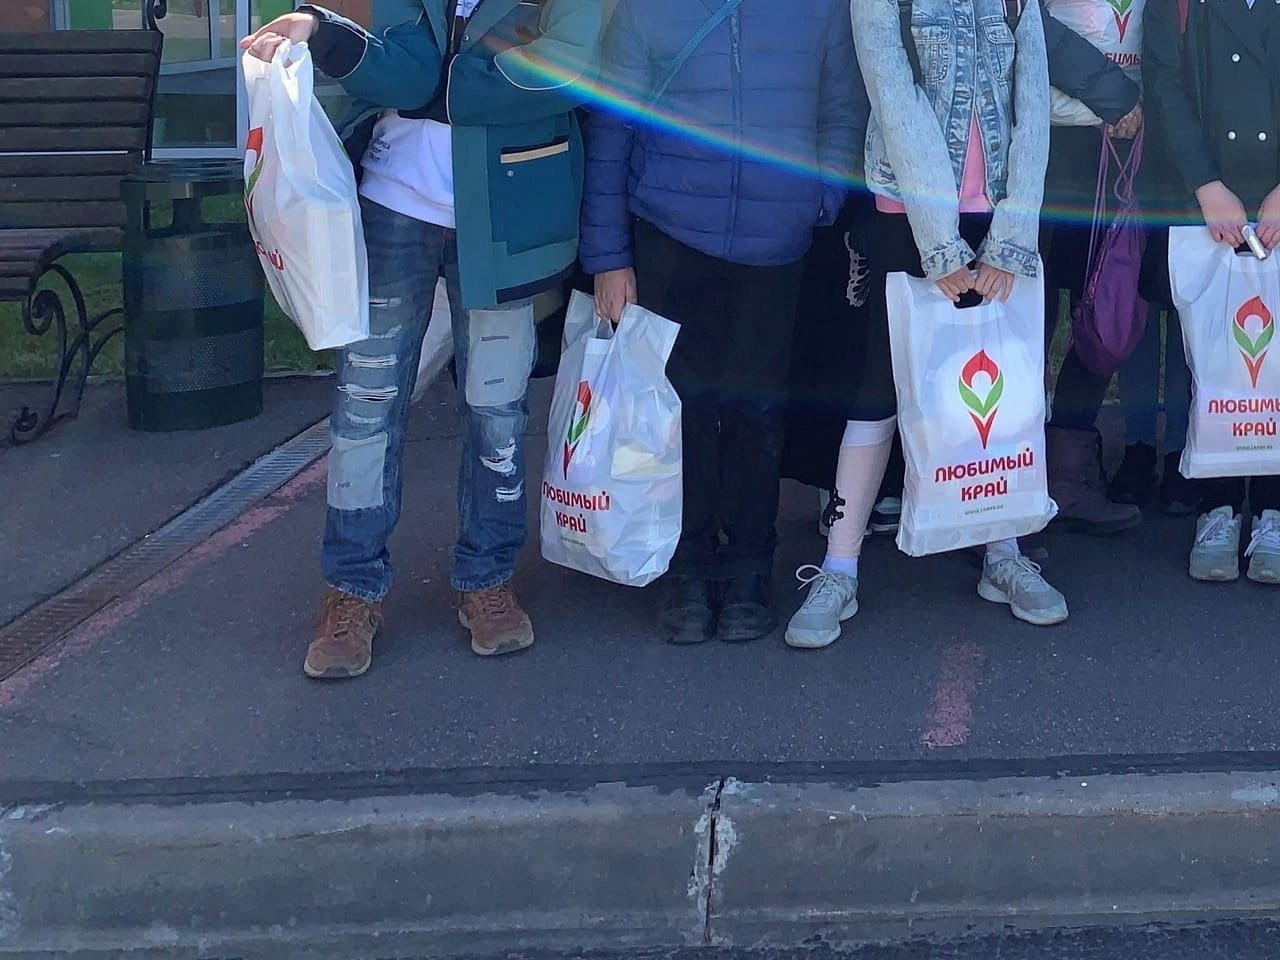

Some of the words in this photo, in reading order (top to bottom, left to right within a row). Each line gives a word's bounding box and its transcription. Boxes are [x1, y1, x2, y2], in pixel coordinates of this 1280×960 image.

[1233, 417, 1277, 436] КРАЙ
[935, 447, 1034, 482] ЛЮБИМЫЙ
[961, 476, 1008, 501] КРАЙ
